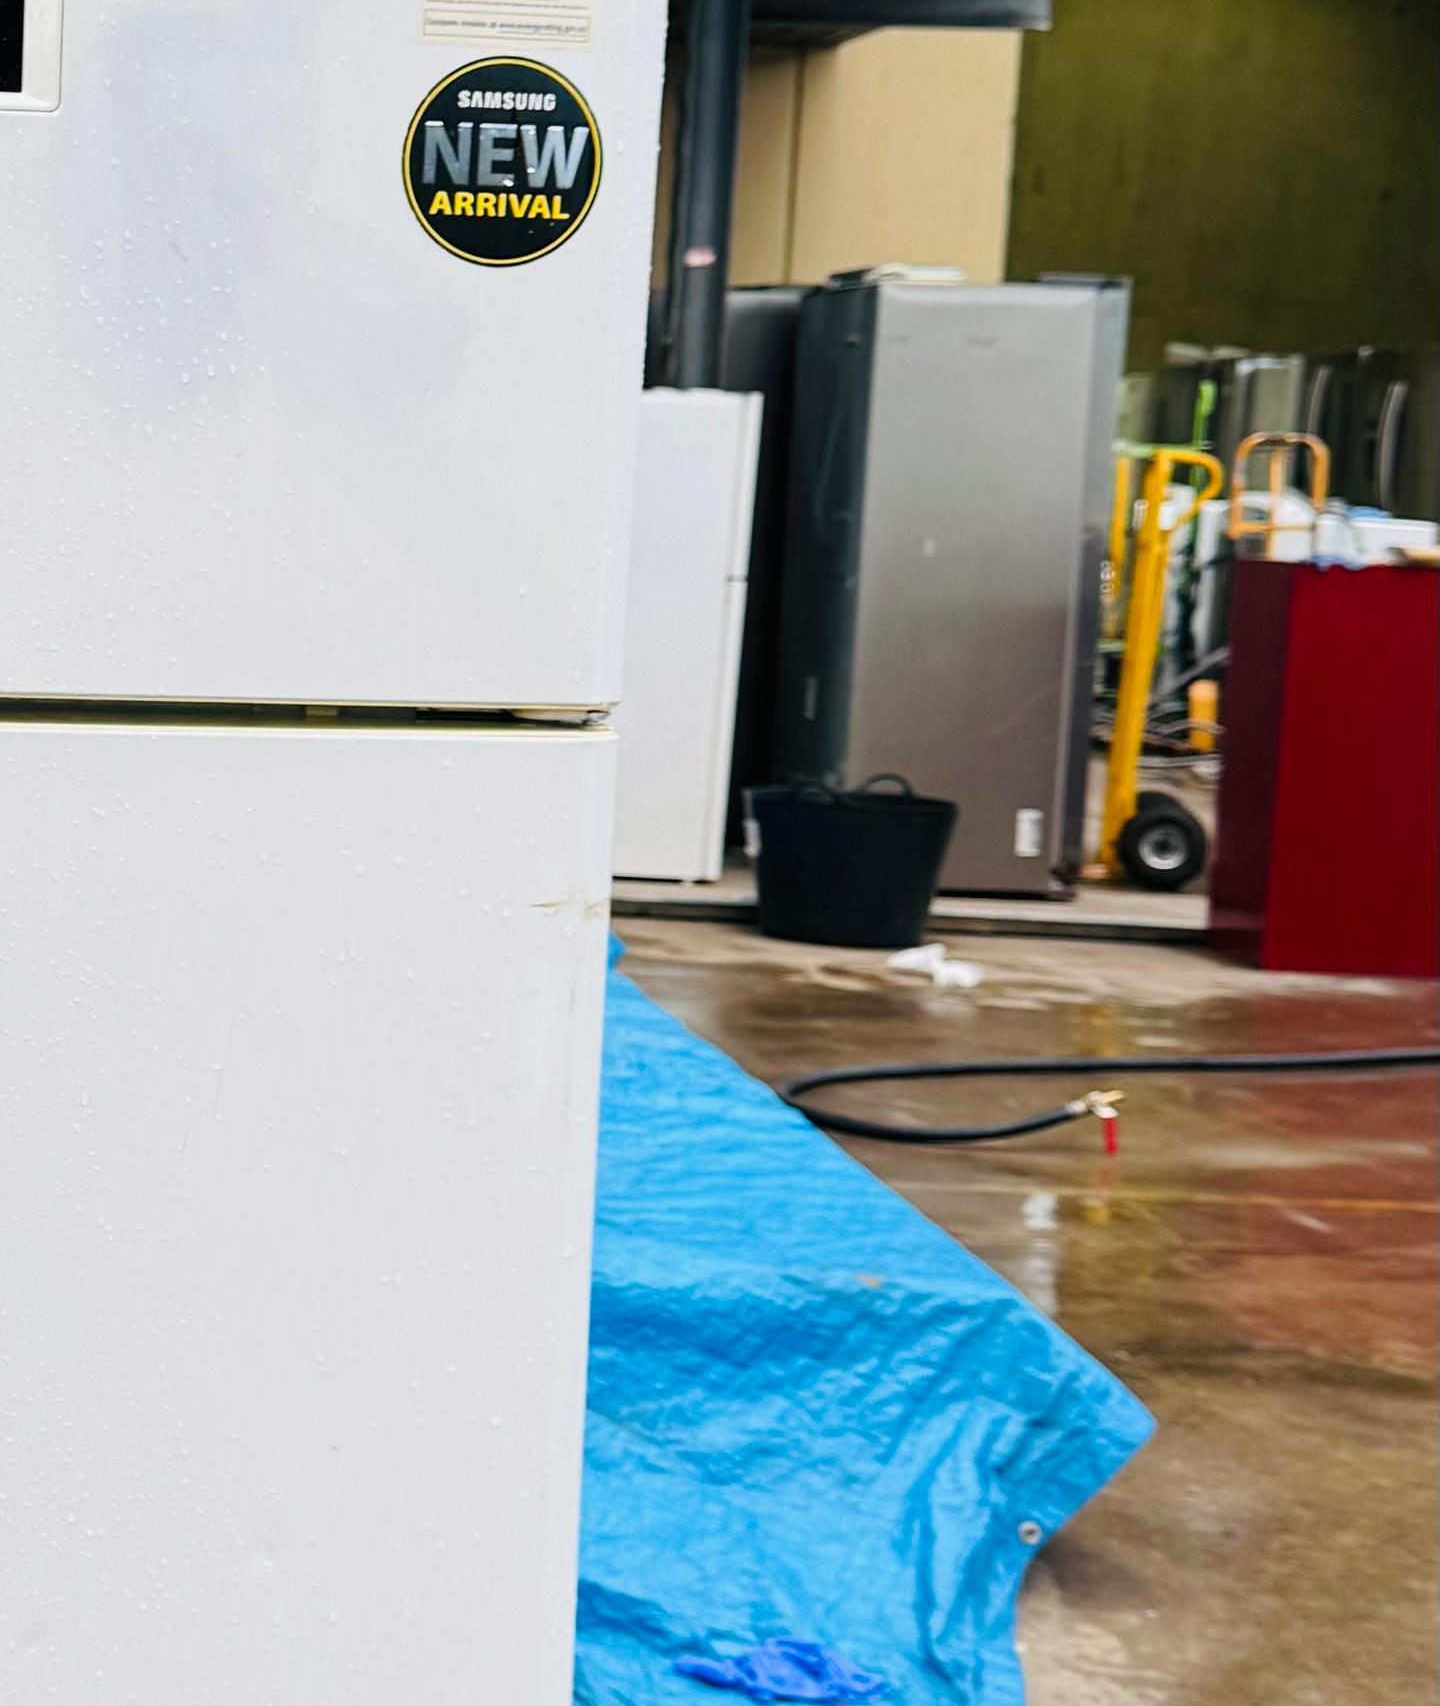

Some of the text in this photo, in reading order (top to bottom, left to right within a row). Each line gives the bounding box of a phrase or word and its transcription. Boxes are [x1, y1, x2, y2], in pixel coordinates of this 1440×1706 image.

[457, 90, 556, 111] SAMSUNG
[422, 120, 590, 189] NEW
[428, 191, 570, 220] ARRIVAL
